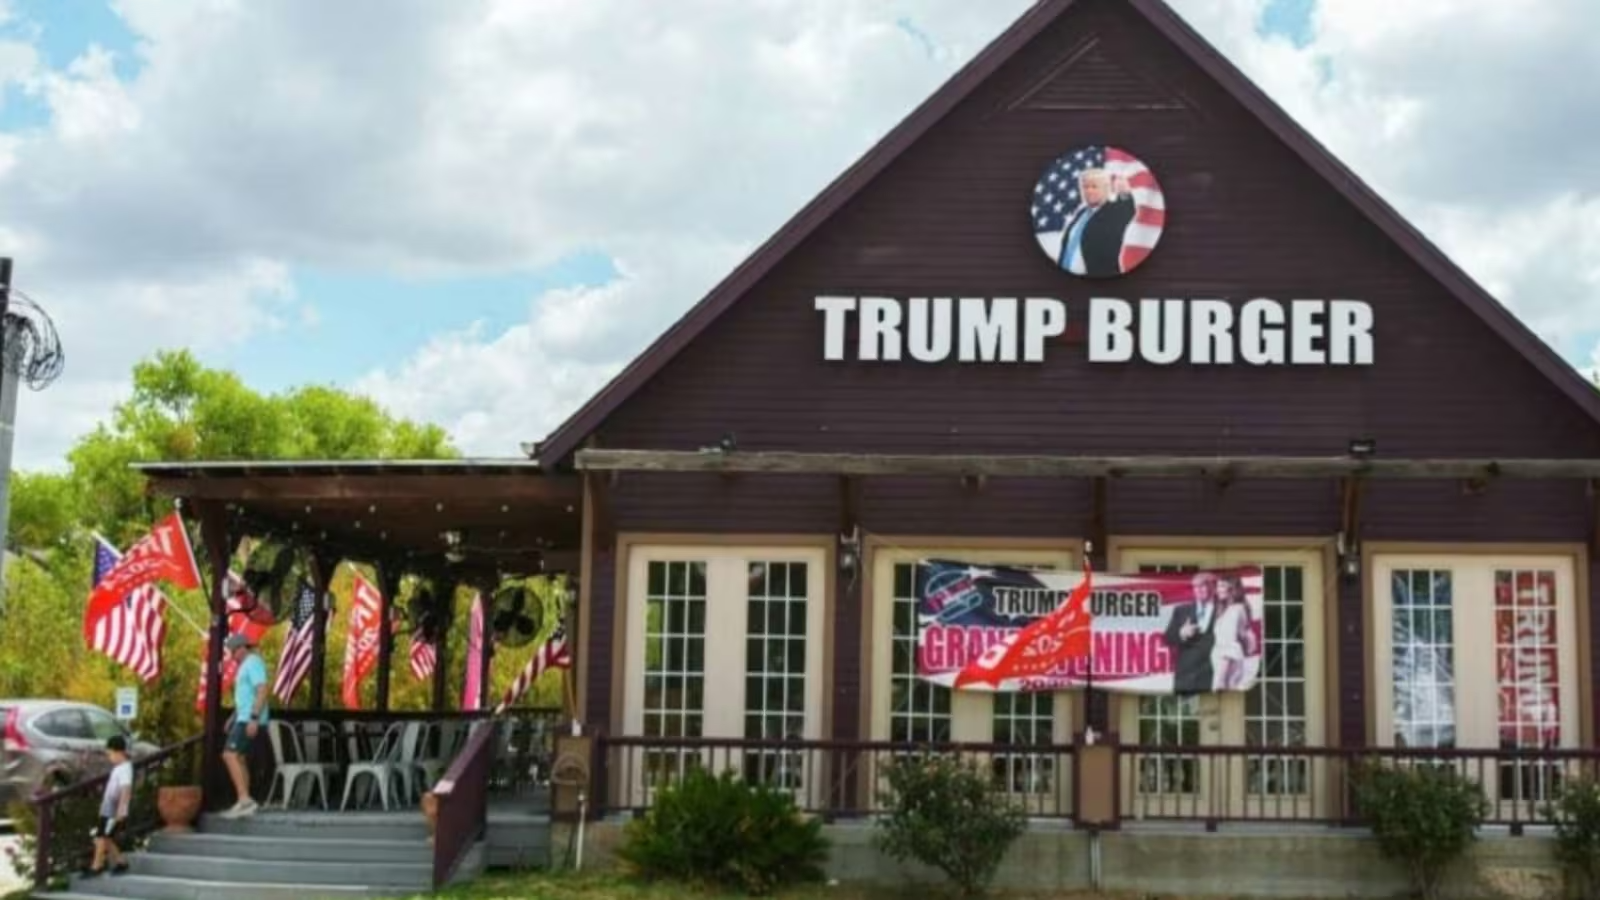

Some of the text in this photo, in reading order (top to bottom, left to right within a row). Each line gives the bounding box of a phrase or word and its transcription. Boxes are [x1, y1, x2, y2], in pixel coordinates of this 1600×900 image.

[815, 296, 1375, 365] TRUMP BURGER
[1088, 591, 1161, 617] URGER
[1516, 583, 1557, 726] TRUMP
